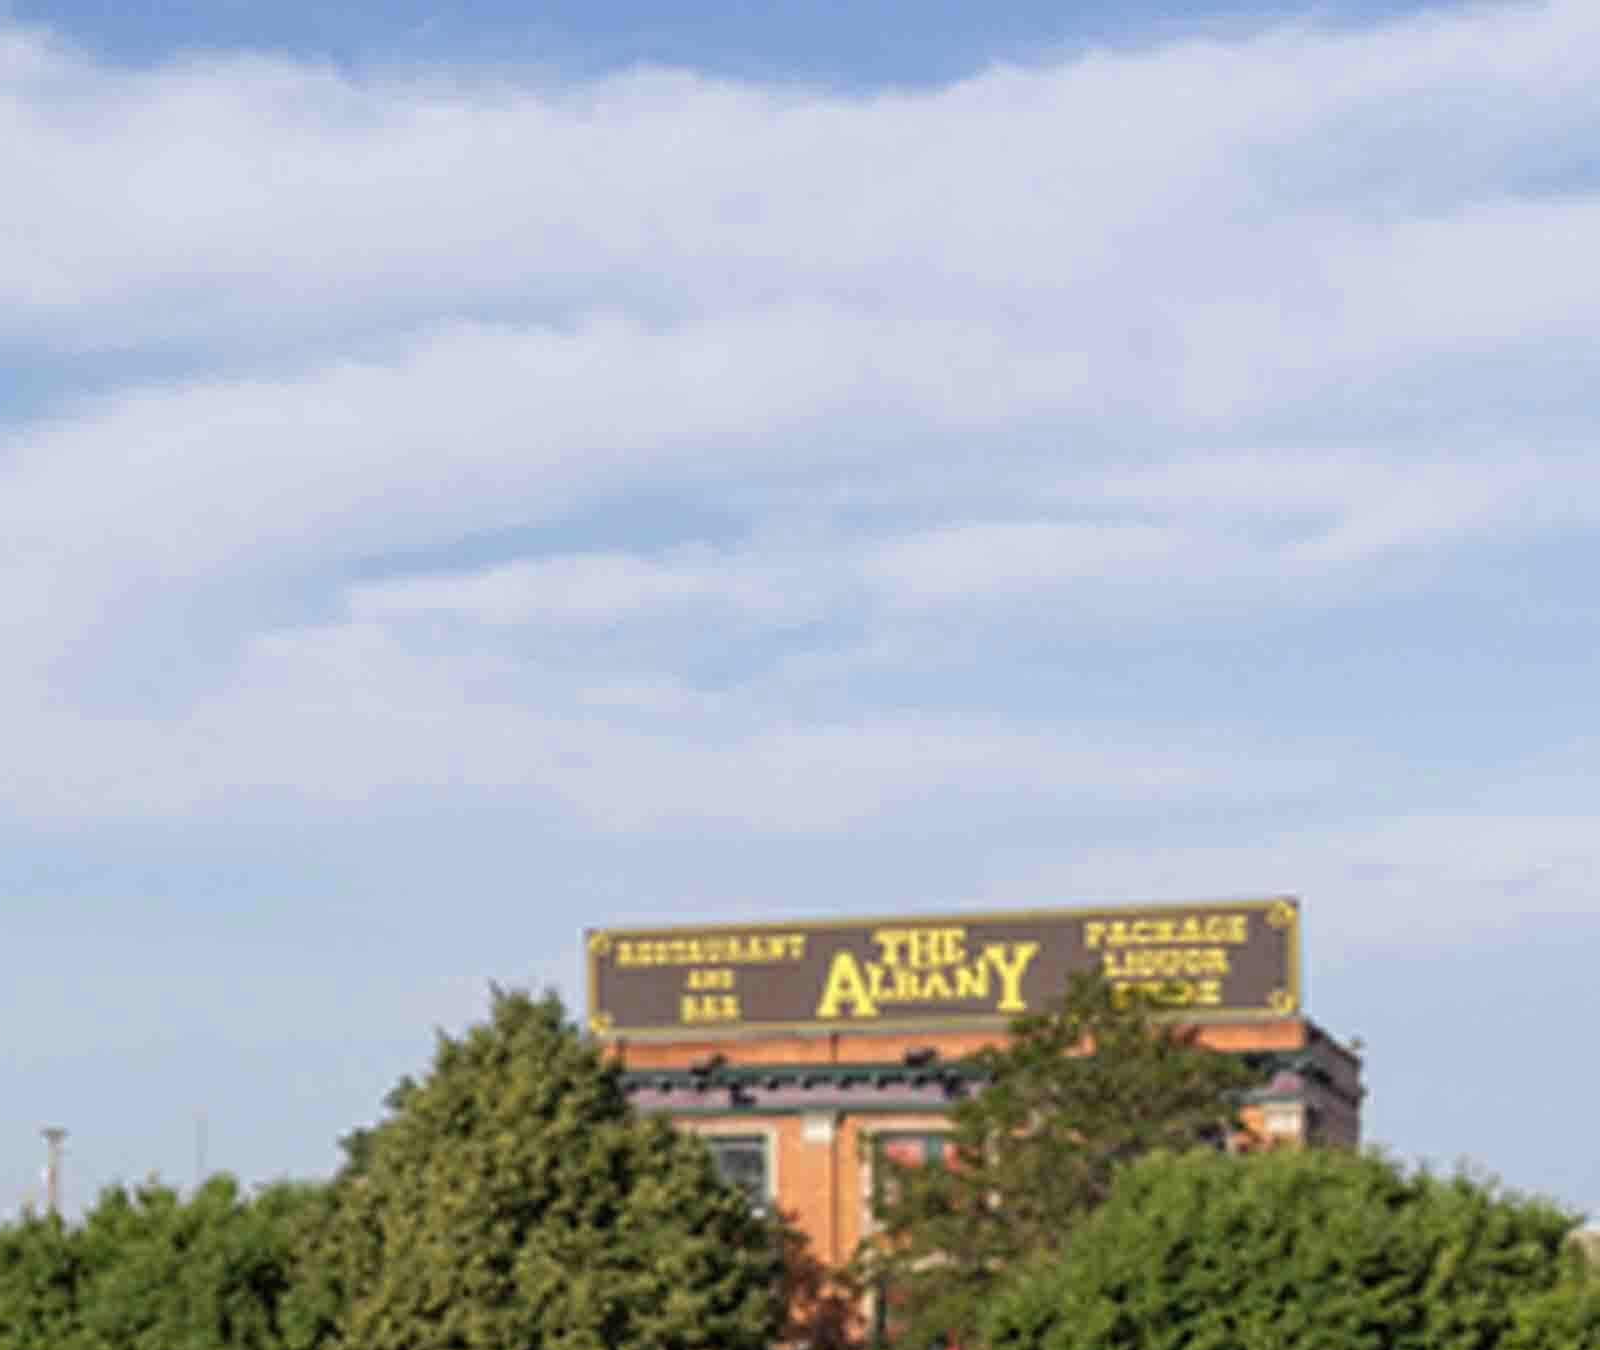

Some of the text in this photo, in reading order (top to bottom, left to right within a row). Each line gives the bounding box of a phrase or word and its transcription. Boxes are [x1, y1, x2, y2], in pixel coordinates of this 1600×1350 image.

[1084, 914, 1248, 947] PACKAGE
[617, 934, 805, 965] RESTAURANT
[873, 927, 965, 968] THE
[688, 970, 734, 989] AND
[816, 942, 1039, 1017] ALBANY
[681, 996, 740, 1023] BAR
